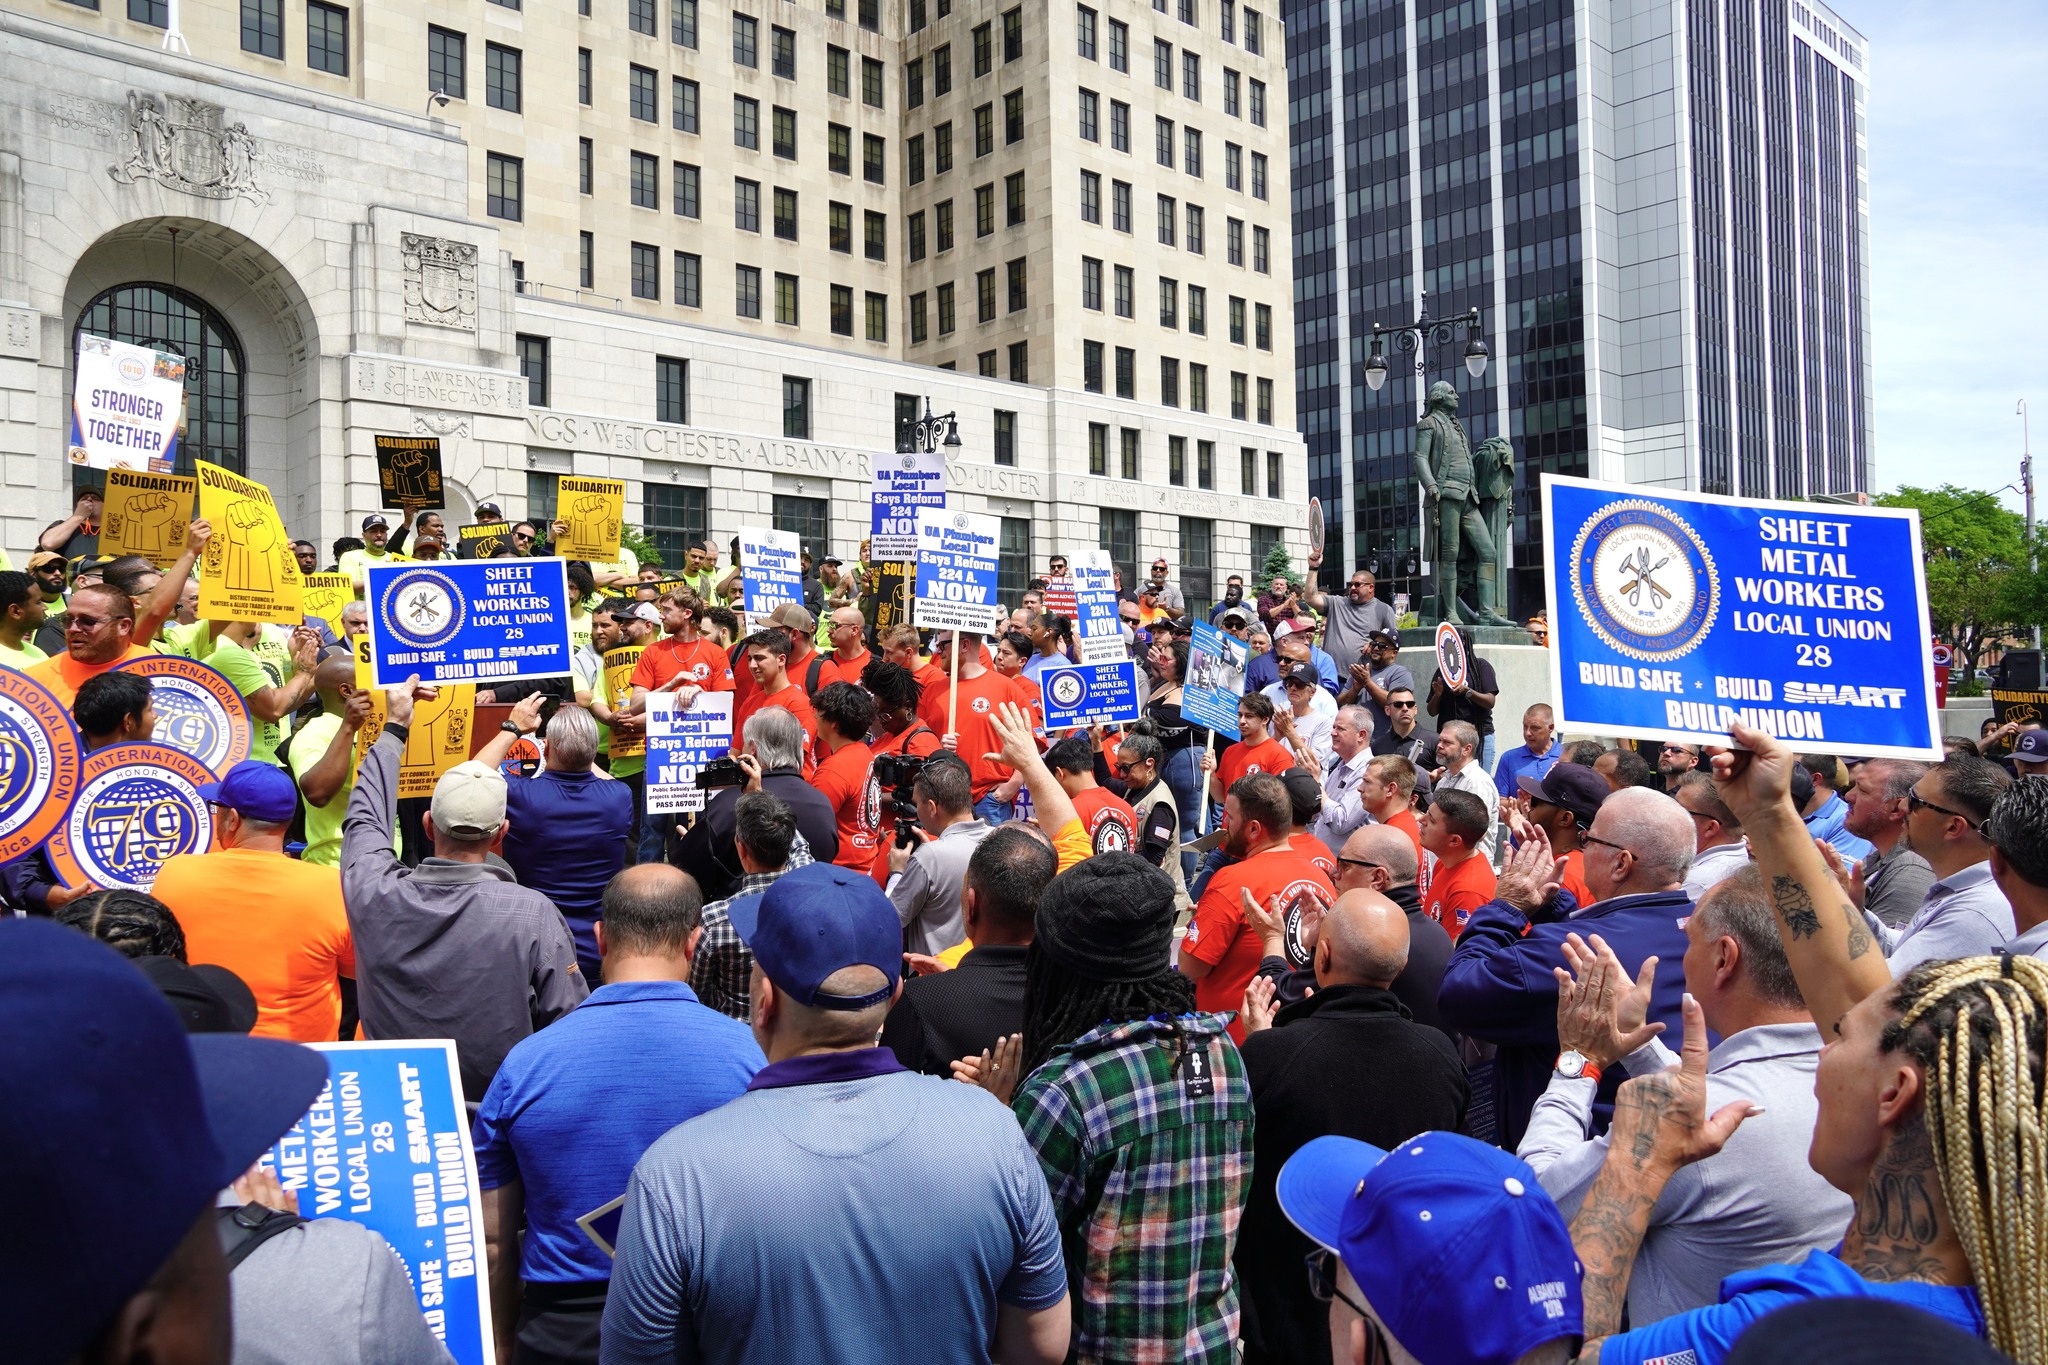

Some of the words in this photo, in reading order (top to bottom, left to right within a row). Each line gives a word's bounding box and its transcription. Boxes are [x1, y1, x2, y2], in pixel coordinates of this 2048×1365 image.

[57, 94, 82, 108] THE
[50, 105, 93, 122] STATE
[100, 114, 116, 128] OF
[50, 118, 111, 138] ADOPTED
[276, 144, 292, 154] OF
[296, 148, 316, 160] THE
[267, 153, 292, 166] NEW
[295, 159, 325, 174] YORK
[169, 180, 229, 198] EXCELSIOR
[388, 366, 406, 380] ST
[412, 369, 496, 392] LAWRENCE
[92, 388, 163, 421] STRONGER
[384, 382, 501, 408] SCHENECTADY
[88, 418, 162, 451] TOGETHER
[377, 437, 438, 450] SOLIDARITY!
[754, 442, 847, 473] ALBANY
[110, 472, 193, 494] SOLIDARITY!
[877, 470, 891, 480] UA
[895, 470, 941, 480] Plumbers
[975, 468, 1040, 496] ULSTER
[201, 467, 273, 507] SOLIDARITY!
[561, 480, 623, 496] SOLIDARITY!
[892, 480, 915, 491] Local
[1104, 482, 1137, 494] CAYUGA
[874, 494, 902, 507] Says
[903, 494, 943, 504] Reform
[1104, 493, 1138, 506] PUTNAM
[1174, 500, 1223, 515] CATTARAUGUS
[1176, 489, 1220, 506] WASHINGTON
[890, 506, 912, 517] 224
[1251, 510, 1287, 522] ONONDAGA
[460, 524, 510, 540] SOLIDARITY!
[924, 526, 941, 538] UA
[944, 527, 994, 546] Plumbers
[1592, 516, 1616, 544] SHEET
[1619, 512, 1649, 524] METAL
[1652, 517, 1693, 555] WORKERS
[1759, 516, 1852, 548] SHEET
[744, 543, 756, 554] UA
[758, 545, 796, 560] Plumbers
[940, 540, 972, 554] Local
[974, 544, 978, 554] 1
[1608, 534, 1630, 552] LOCAL
[1632, 532, 1656, 544] UNION
[1656, 540, 1669, 552] NO.
[1668, 550, 1678, 560] 28
[758, 556, 781, 568] Local
[920, 550, 949, 566] Says
[954, 554, 996, 572] Reform
[1761, 548, 1857, 579] METAL
[303, 576, 350, 588] IDARITY!
[485, 566, 534, 581] SHEET
[744, 568, 768, 582] Says
[769, 570, 800, 584] Reform
[938, 566, 964, 580] 224
[966, 572, 978, 584] A.
[486, 582, 536, 596] METAL
[927, 580, 988, 604] NOW
[1734, 576, 1885, 612] WORKERS
[473, 596, 550, 612] WORKERS
[916, 607, 937, 616] projects
[937, 608, 954, 616] should
[968, 612, 983, 620] work
[920, 600, 936, 608] Public
[937, 602, 956, 610] Subsidy
[963, 605, 992, 614] construction
[1606, 594, 1645, 628] CHARTERED
[1646, 618, 1664, 629] OCT.
[1674, 600, 1687, 618] 1913
[472, 615, 513, 627] LOCAL
[515, 613, 554, 624] UNION
[922, 616, 940, 624] PASS
[941, 618, 962, 626] A6708
[968, 621, 988, 630] S6378
[1584, 583, 1601, 610] NEW
[1598, 609, 1620, 633] YORK
[1620, 630, 1642, 646] CITY
[1645, 637, 1667, 649] AND
[1669, 624, 1693, 646] LONG
[1692, 590, 1708, 626] ISLAND
[1733, 610, 1810, 636] LOCAL
[1816, 617, 1892, 641] UNION
[505, 628, 524, 640] 28
[387, 652, 420, 666] BUILD
[420, 650, 446, 663] SAFE
[463, 648, 494, 661] BUILD
[498, 644, 560, 658] SMART
[604, 650, 642, 670] SOLIDAR
[1796, 644, 1833, 668] 28
[435, 663, 474, 680] BUILD
[476, 660, 518, 676] UNION
[1096, 664, 1120, 674] SHEET
[1096, 673, 1121, 682] METAL
[141, 662, 243, 720] INTERNATIONAL
[161, 679, 200, 694] HONOR
[1090, 680, 1128, 690] WORKERS
[1090, 690, 1109, 698] LOCAL
[1110, 688, 1130, 696] UNION
[1579, 662, 1635, 689] BUILD
[1638, 668, 1684, 694] SAFE
[1715, 676, 1773, 702] BUILD
[1783, 682, 1906, 709] SMART
[1105, 696, 1116, 704] 28
[652, 711, 670, 722] UA
[672, 710, 726, 722] Plumbers
[1665, 700, 1736, 733] BUILD
[1739, 707, 1824, 740] UNION
[212, 704, 228, 749] STRENGTH
[670, 722, 702, 734] Local
[706, 722, 710, 732] 1
[20, 716, 48, 781] STRENGTH
[230, 724, 247, 764] UNION
[650, 737, 682, 752] Says
[685, 736, 730, 748] Reform
[669, 750, 696, 763] 224
[698, 750, 712, 762] A.
[54, 742, 74, 801] UNION
[88, 749, 208, 786] INTERNATIONA
[116, 768, 158, 780] HONOR
[178, 782, 208, 830] STRENGTH
[675, 800, 697, 808] A6708
[73, 790, 96, 840] JUSTICE
[87, 800, 197, 869] 79
[339, 1072, 365, 1136] UNION
[398, 1062, 431, 1164] SMART
[371, 1120, 395, 1153] 28
[347, 1140, 372, 1213] LOCAL
[433, 1132, 468, 1202] UNION
[413, 1172, 438, 1228] BUILD
[441, 1206, 475, 1278] BUILD
[420, 1259, 444, 1308] SAFE
